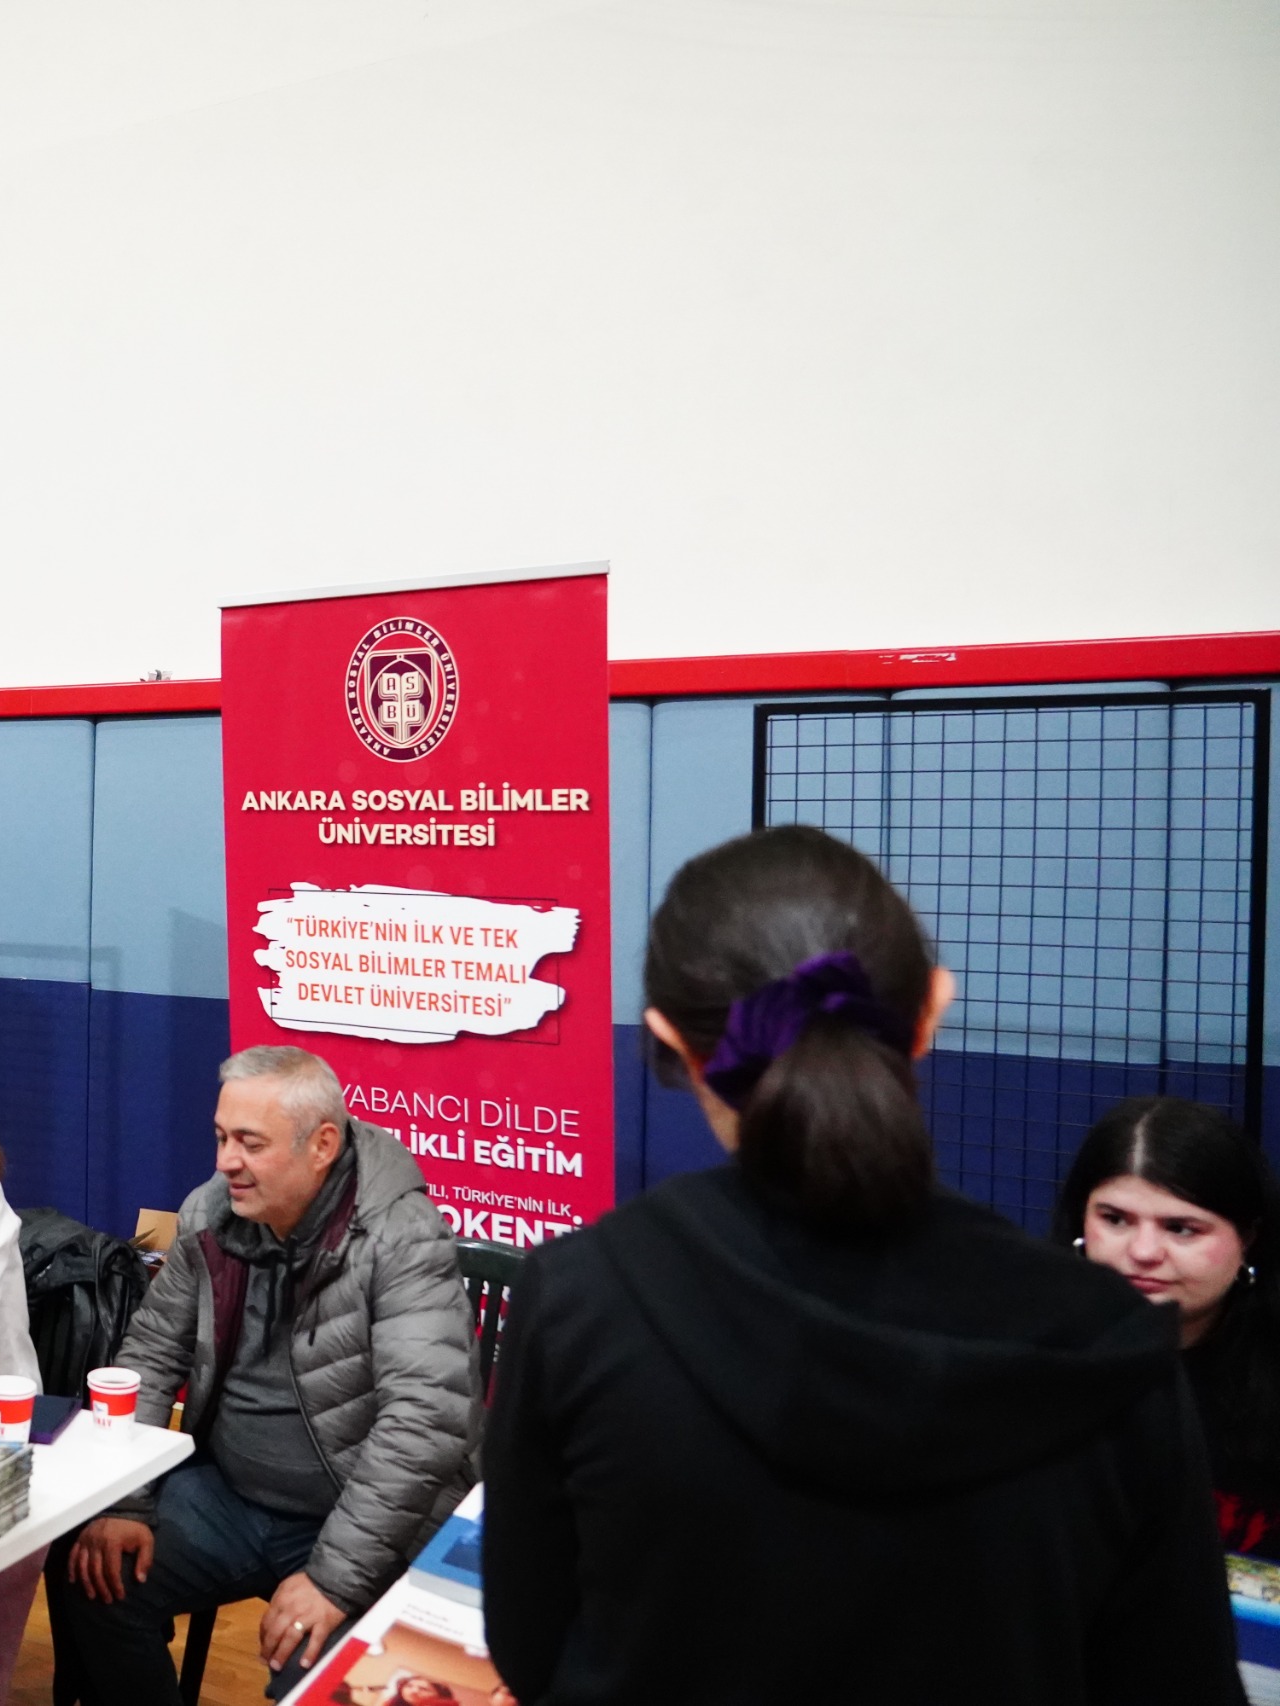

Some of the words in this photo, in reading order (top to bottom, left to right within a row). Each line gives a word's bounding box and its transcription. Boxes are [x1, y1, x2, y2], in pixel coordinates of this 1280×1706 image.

[241, 790, 346, 811] ANKARA
[351, 789, 454, 811] SOSYAL
[460, 781, 590, 812] BİLİMLER
[318, 816, 496, 847] ÜNİVERSİTESİ
[413, 919, 444, 945] İLK
[449, 925, 474, 946] VE
[480, 927, 519, 949] TEK
[285, 949, 353, 972] SOSYAL
[359, 950, 446, 979] BİLİMLER
[451, 960, 527, 985] TEMALI
[298, 982, 365, 1006] DEVLET
[480, 1097, 580, 1138] DİLDE
[473, 1134, 583, 1178] EĞİTİM
[452, 1185, 544, 1214] TÜRKİYE'NİN
[547, 1198, 572, 1218] İLK
